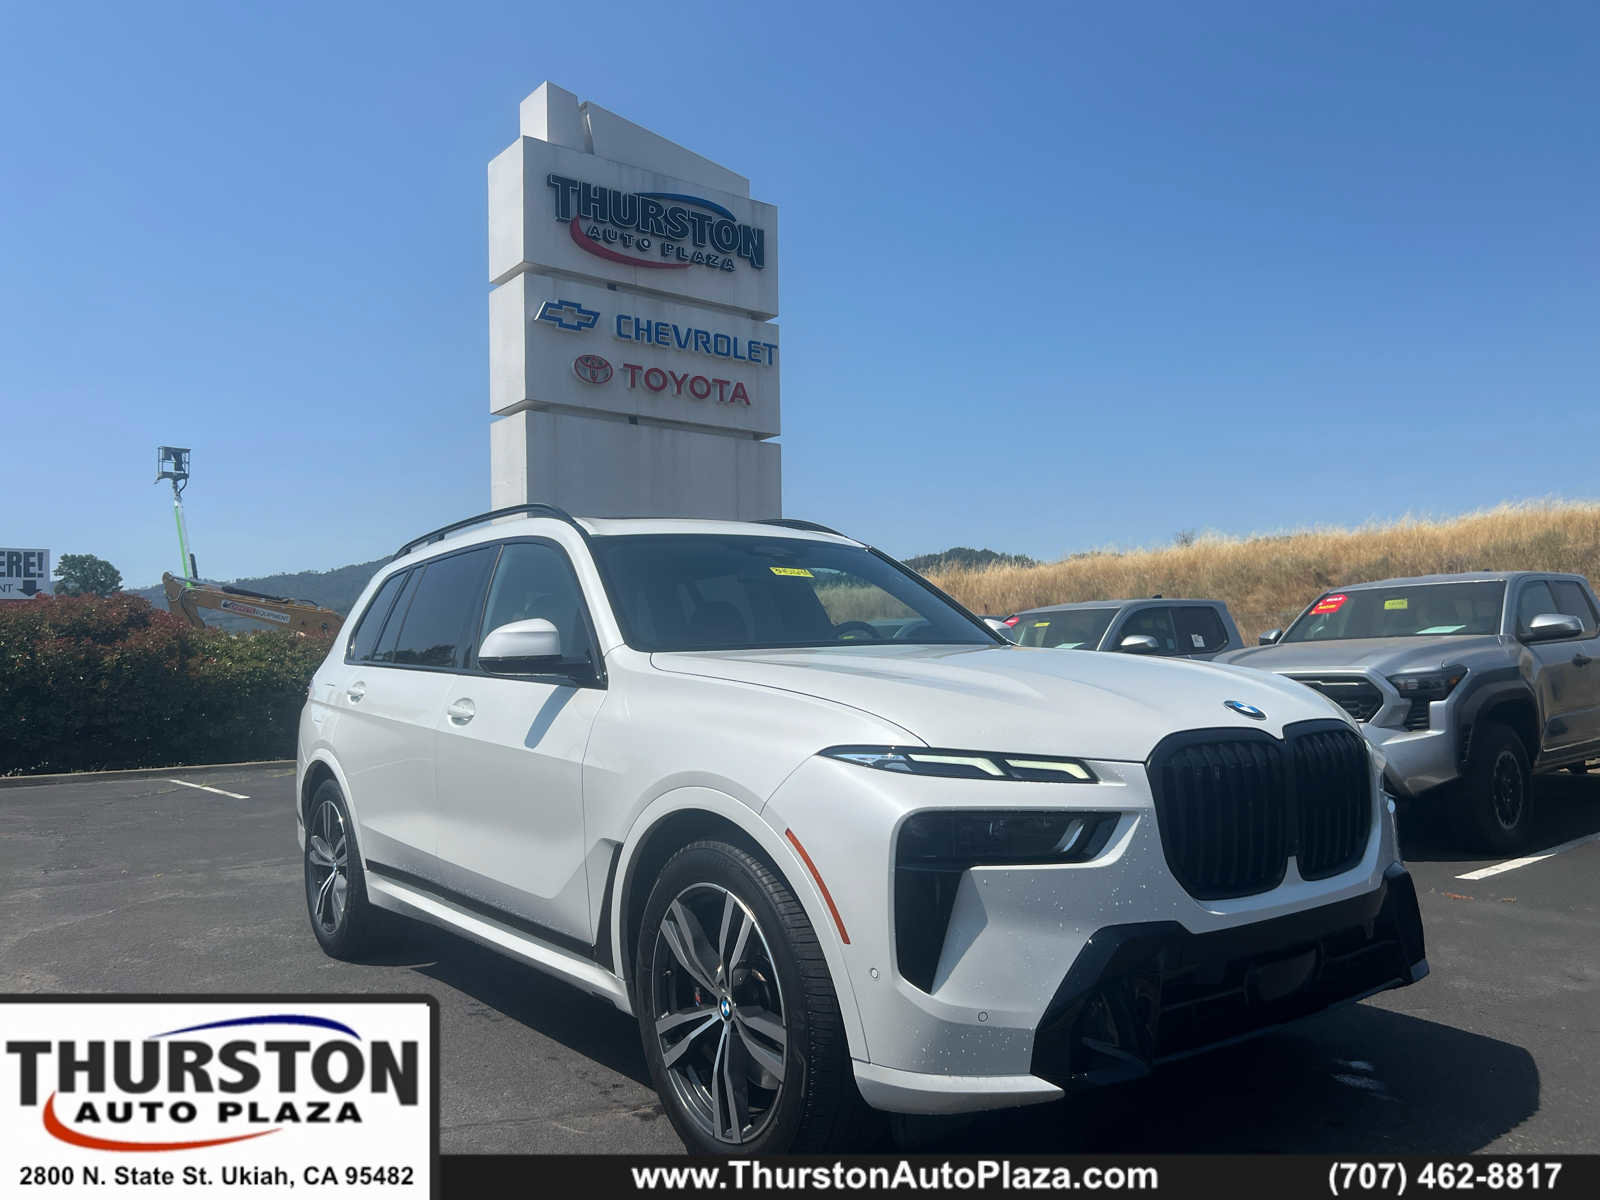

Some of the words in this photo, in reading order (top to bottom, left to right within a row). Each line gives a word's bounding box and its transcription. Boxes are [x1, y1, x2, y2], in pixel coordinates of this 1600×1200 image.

[548, 174, 765, 269] THURSTON
[586, 225, 651, 251] AUTO
[661, 241, 736, 272] PLAZA
[615, 314, 778, 366] CHEVROLET
[622, 362, 751, 406] TOYOTA
